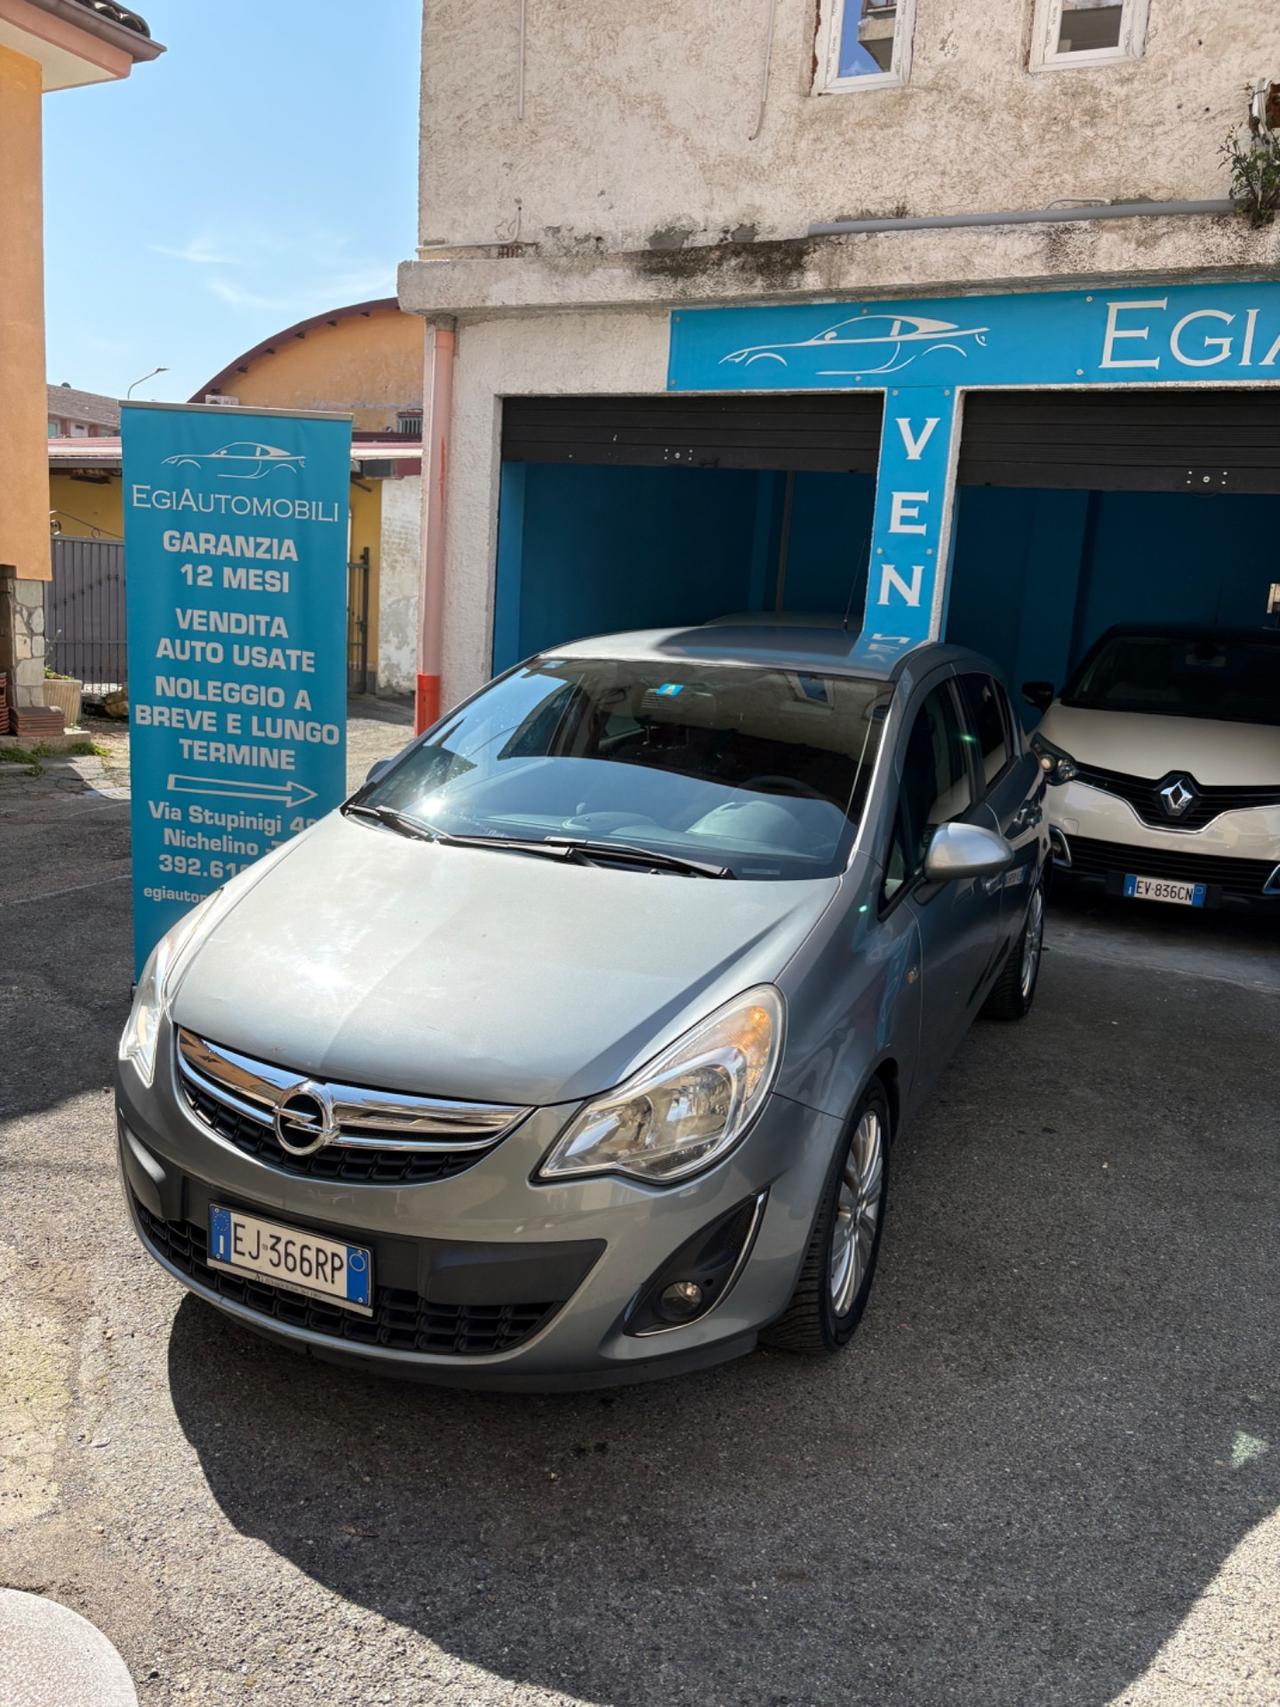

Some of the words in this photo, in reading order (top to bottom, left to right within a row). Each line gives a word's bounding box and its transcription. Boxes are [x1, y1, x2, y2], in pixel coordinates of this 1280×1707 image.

[162, 530, 298, 561] GARANZIA
[180, 564, 213, 587] 12
[223, 566, 289, 593] MESI
[175, 608, 288, 638] VENDITA
[155, 637, 224, 664] AUTO
[233, 644, 315, 673] USATE
[155, 676, 285, 708] NOLEGGIO
[294, 690, 312, 711] A
[135, 704, 217, 732] BREVE
[226, 713, 242, 735] E
[251, 716, 340, 745] LUNGO
[179, 739, 296, 770] TERMINE
[149, 800, 182, 821] Via
[189, 805, 282, 837] Stupinigi
[163, 828, 259, 857] Nichelino
